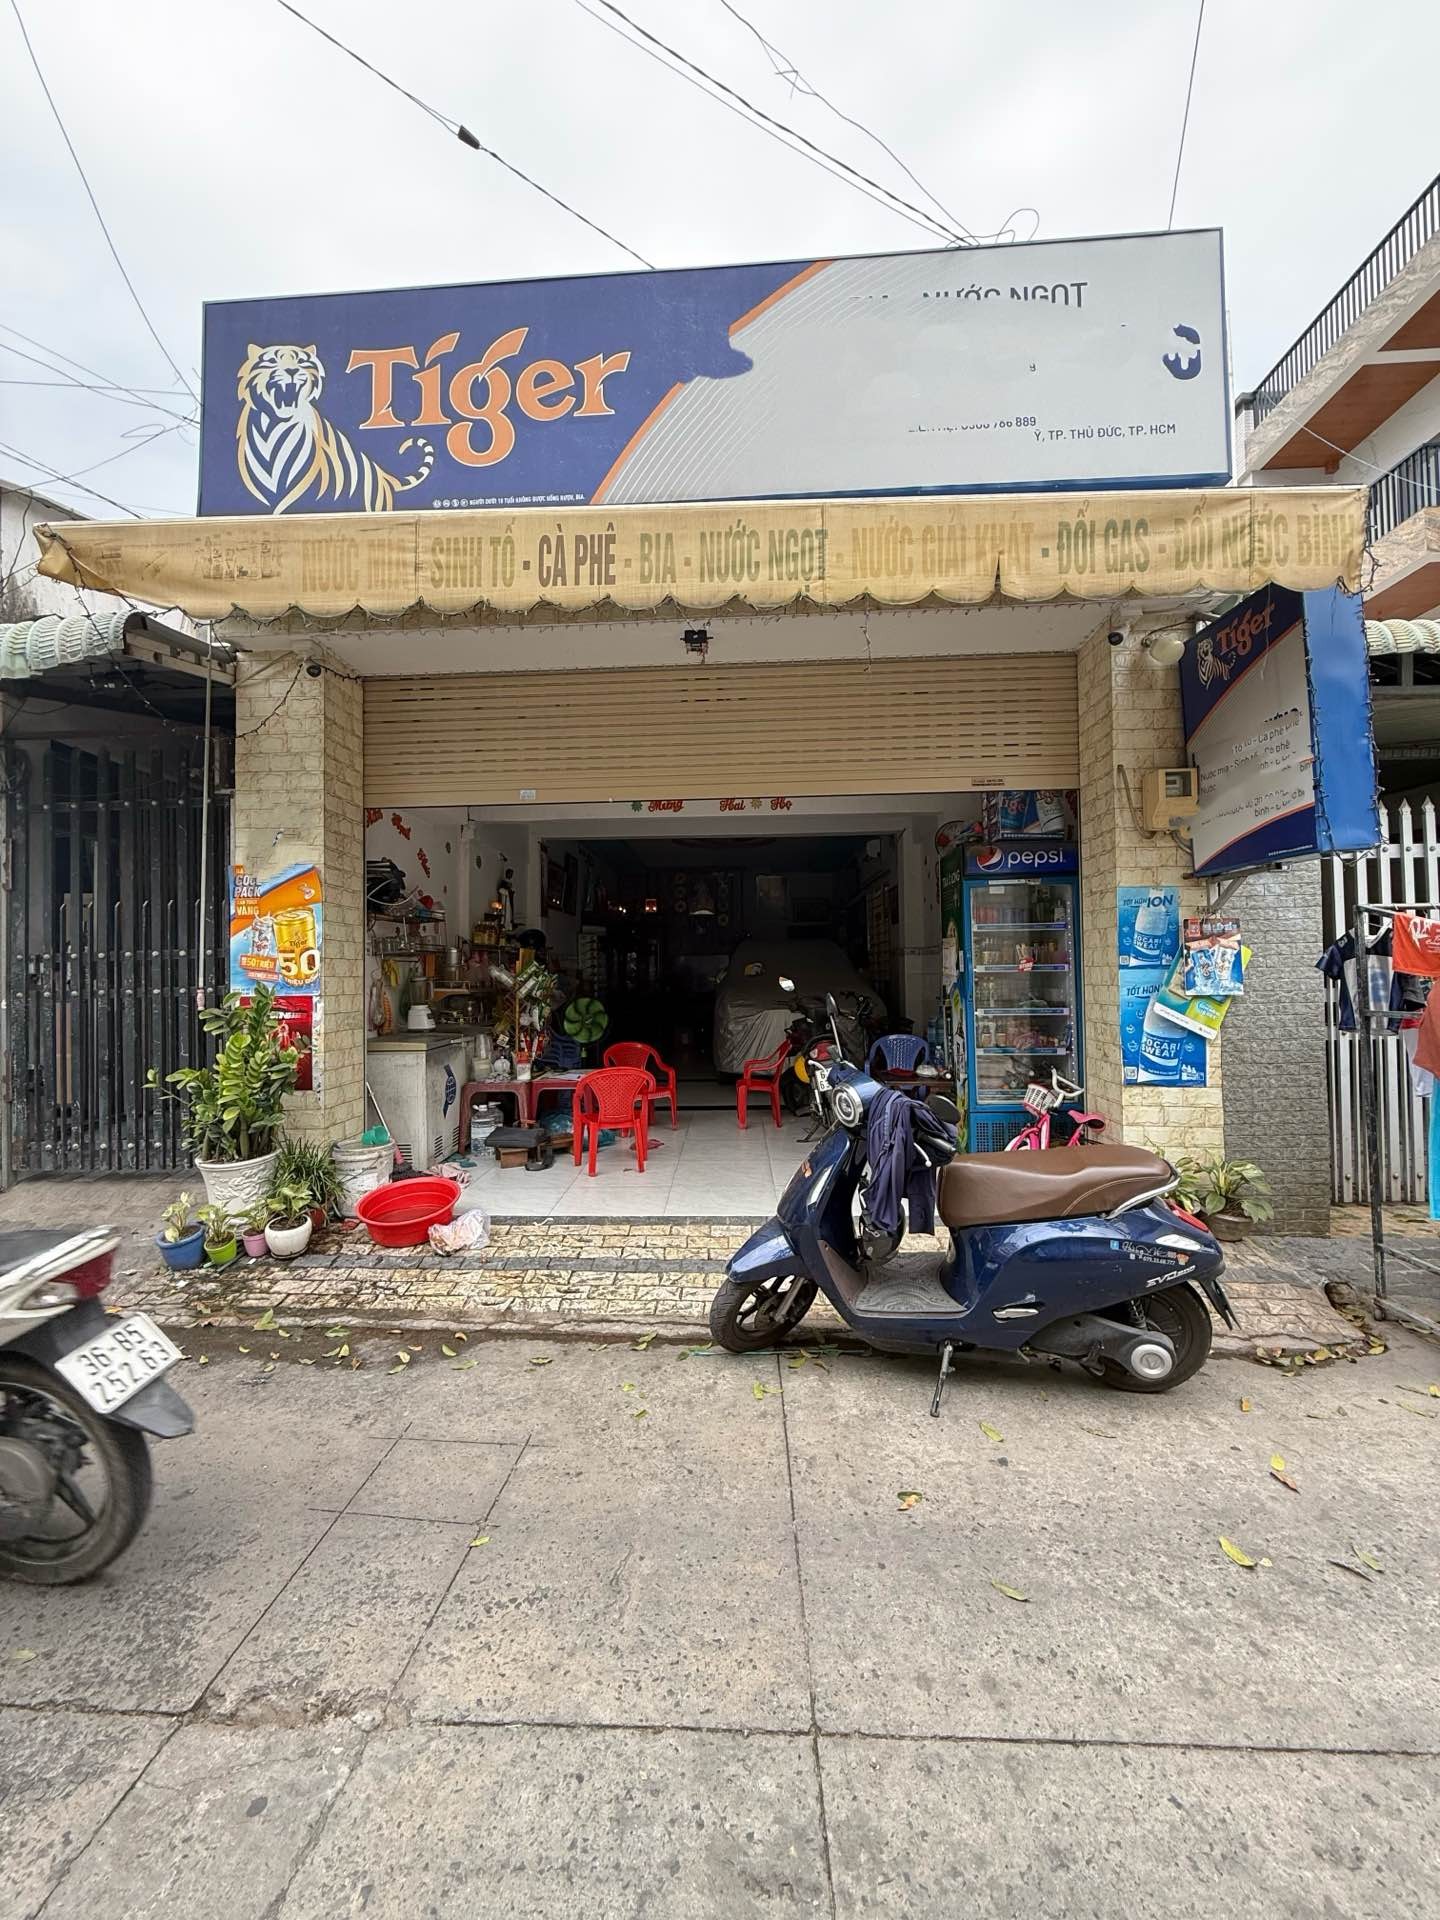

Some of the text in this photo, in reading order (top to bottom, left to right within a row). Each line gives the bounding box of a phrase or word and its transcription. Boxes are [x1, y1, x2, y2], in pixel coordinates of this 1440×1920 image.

[346, 326, 632, 467] Tiger
[1015, 416, 1037, 427] 889
[1048, 429, 1068, 441] TP.
[1070, 424, 1094, 440] THỦ
[1097, 424, 1126, 438] ĐỨC,
[1128, 425, 1148, 436] TP.
[1150, 423, 1176, 435] HCM
[430, 536, 483, 589] SINH
[490, 517, 516, 588] TỐ
[538, 523, 567, 587] CÀ
[574, 522, 616, 586] PHÊ
[639, 532, 677, 584] BIA
[699, 518, 761, 583] NƯỚC
[768, 528, 828, 592] NGỌT
[851, 516, 914, 578] NƯỚC
[1057, 499, 1096, 574] ĐỔI
[1104, 518, 1150, 573] GAS
[1174, 494, 1212, 571] ĐỔI
[1296, 503, 1356, 567] BÌNH
[1215, 601, 1276, 656] Tiger
[1007, 848, 1064, 869] pepsi
[1147, 894, 1174, 908] ION
[278, 949, 320, 978] 50
[78, 1322, 147, 1376] 36-B5
[90, 1340, 172, 1404] 252.63
